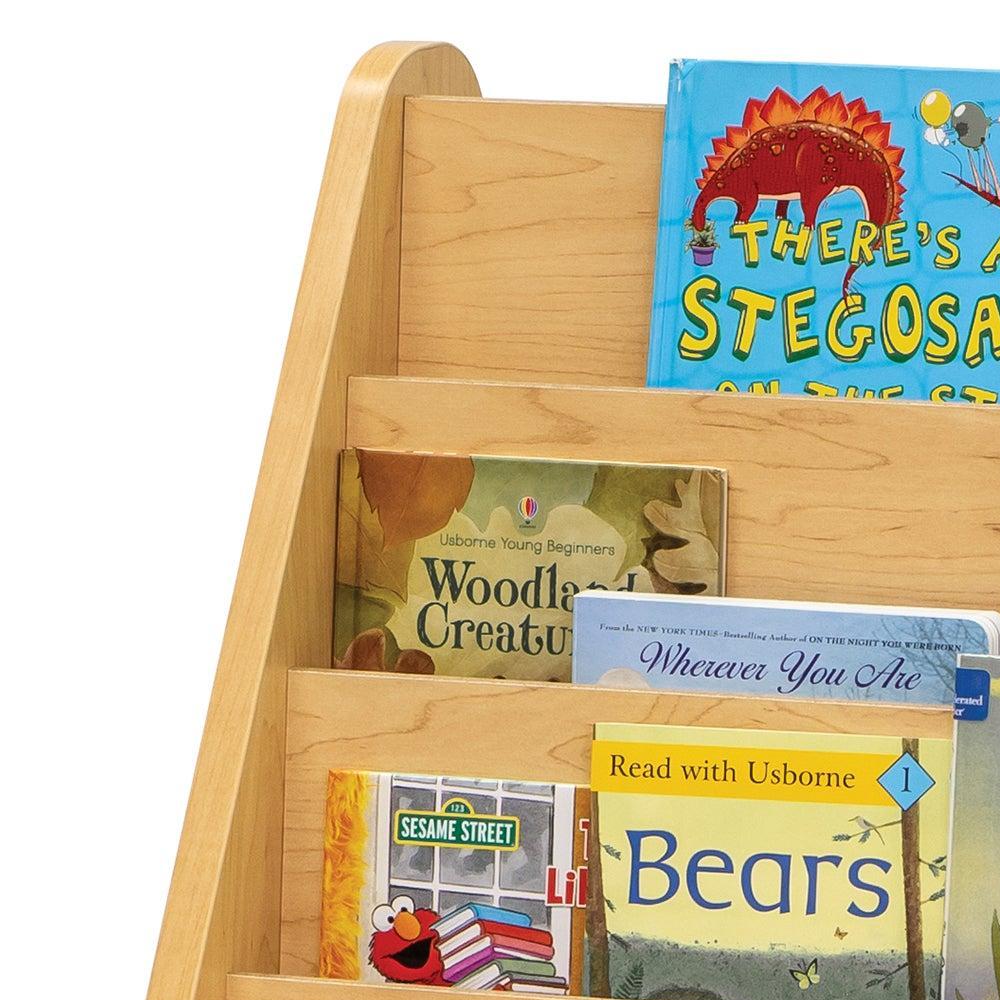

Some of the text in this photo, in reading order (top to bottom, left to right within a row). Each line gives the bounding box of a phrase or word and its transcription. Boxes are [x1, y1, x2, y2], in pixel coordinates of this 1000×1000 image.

[731, 219, 960, 269] THERE'S
[439, 533, 616, 557] Usborne Young Beginners
[600, 623, 621, 632] From
[622, 624, 635, 632] the
[637, 625, 659, 634] NEW
[661, 626, 687, 636] YORK
[769, 633, 797, 642] Author
[799, 634, 808, 643] of
[808, 636, 823, 644] ON
[825, 636, 846, 645] THE
[847, 637, 880, 647] NIGHT
[881, 639, 902, 648] YOU
[905, 641, 933, 651] WERE
[934, 642, 962, 652] BORN
[639, 640, 922, 694] Wherever You Are
[609, 754, 672, 779] Read
[681, 760, 737, 782] with
[748, 761, 856, 788] Usborne
[450, 804, 465, 813] 123
[400, 816, 514, 845] SESAME STREET
[624, 829, 894, 919] Bears
